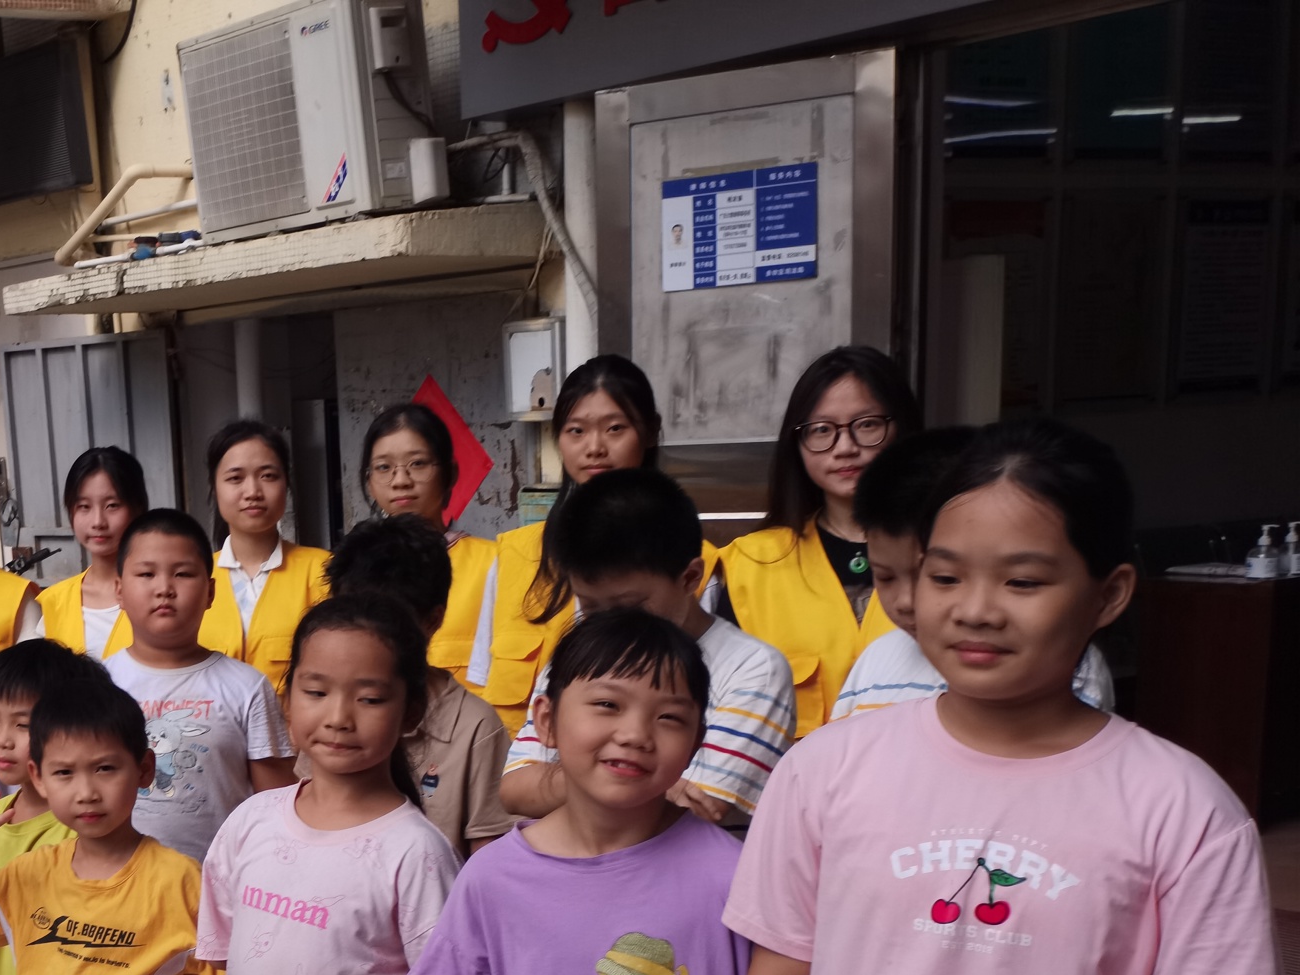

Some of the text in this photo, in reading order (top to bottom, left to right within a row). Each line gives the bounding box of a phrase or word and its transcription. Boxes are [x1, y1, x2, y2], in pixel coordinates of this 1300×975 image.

[309, 19, 330, 33] GREE
[890, 838, 1081, 900] CHERRY
[985, 928, 1033, 947] CLUB
